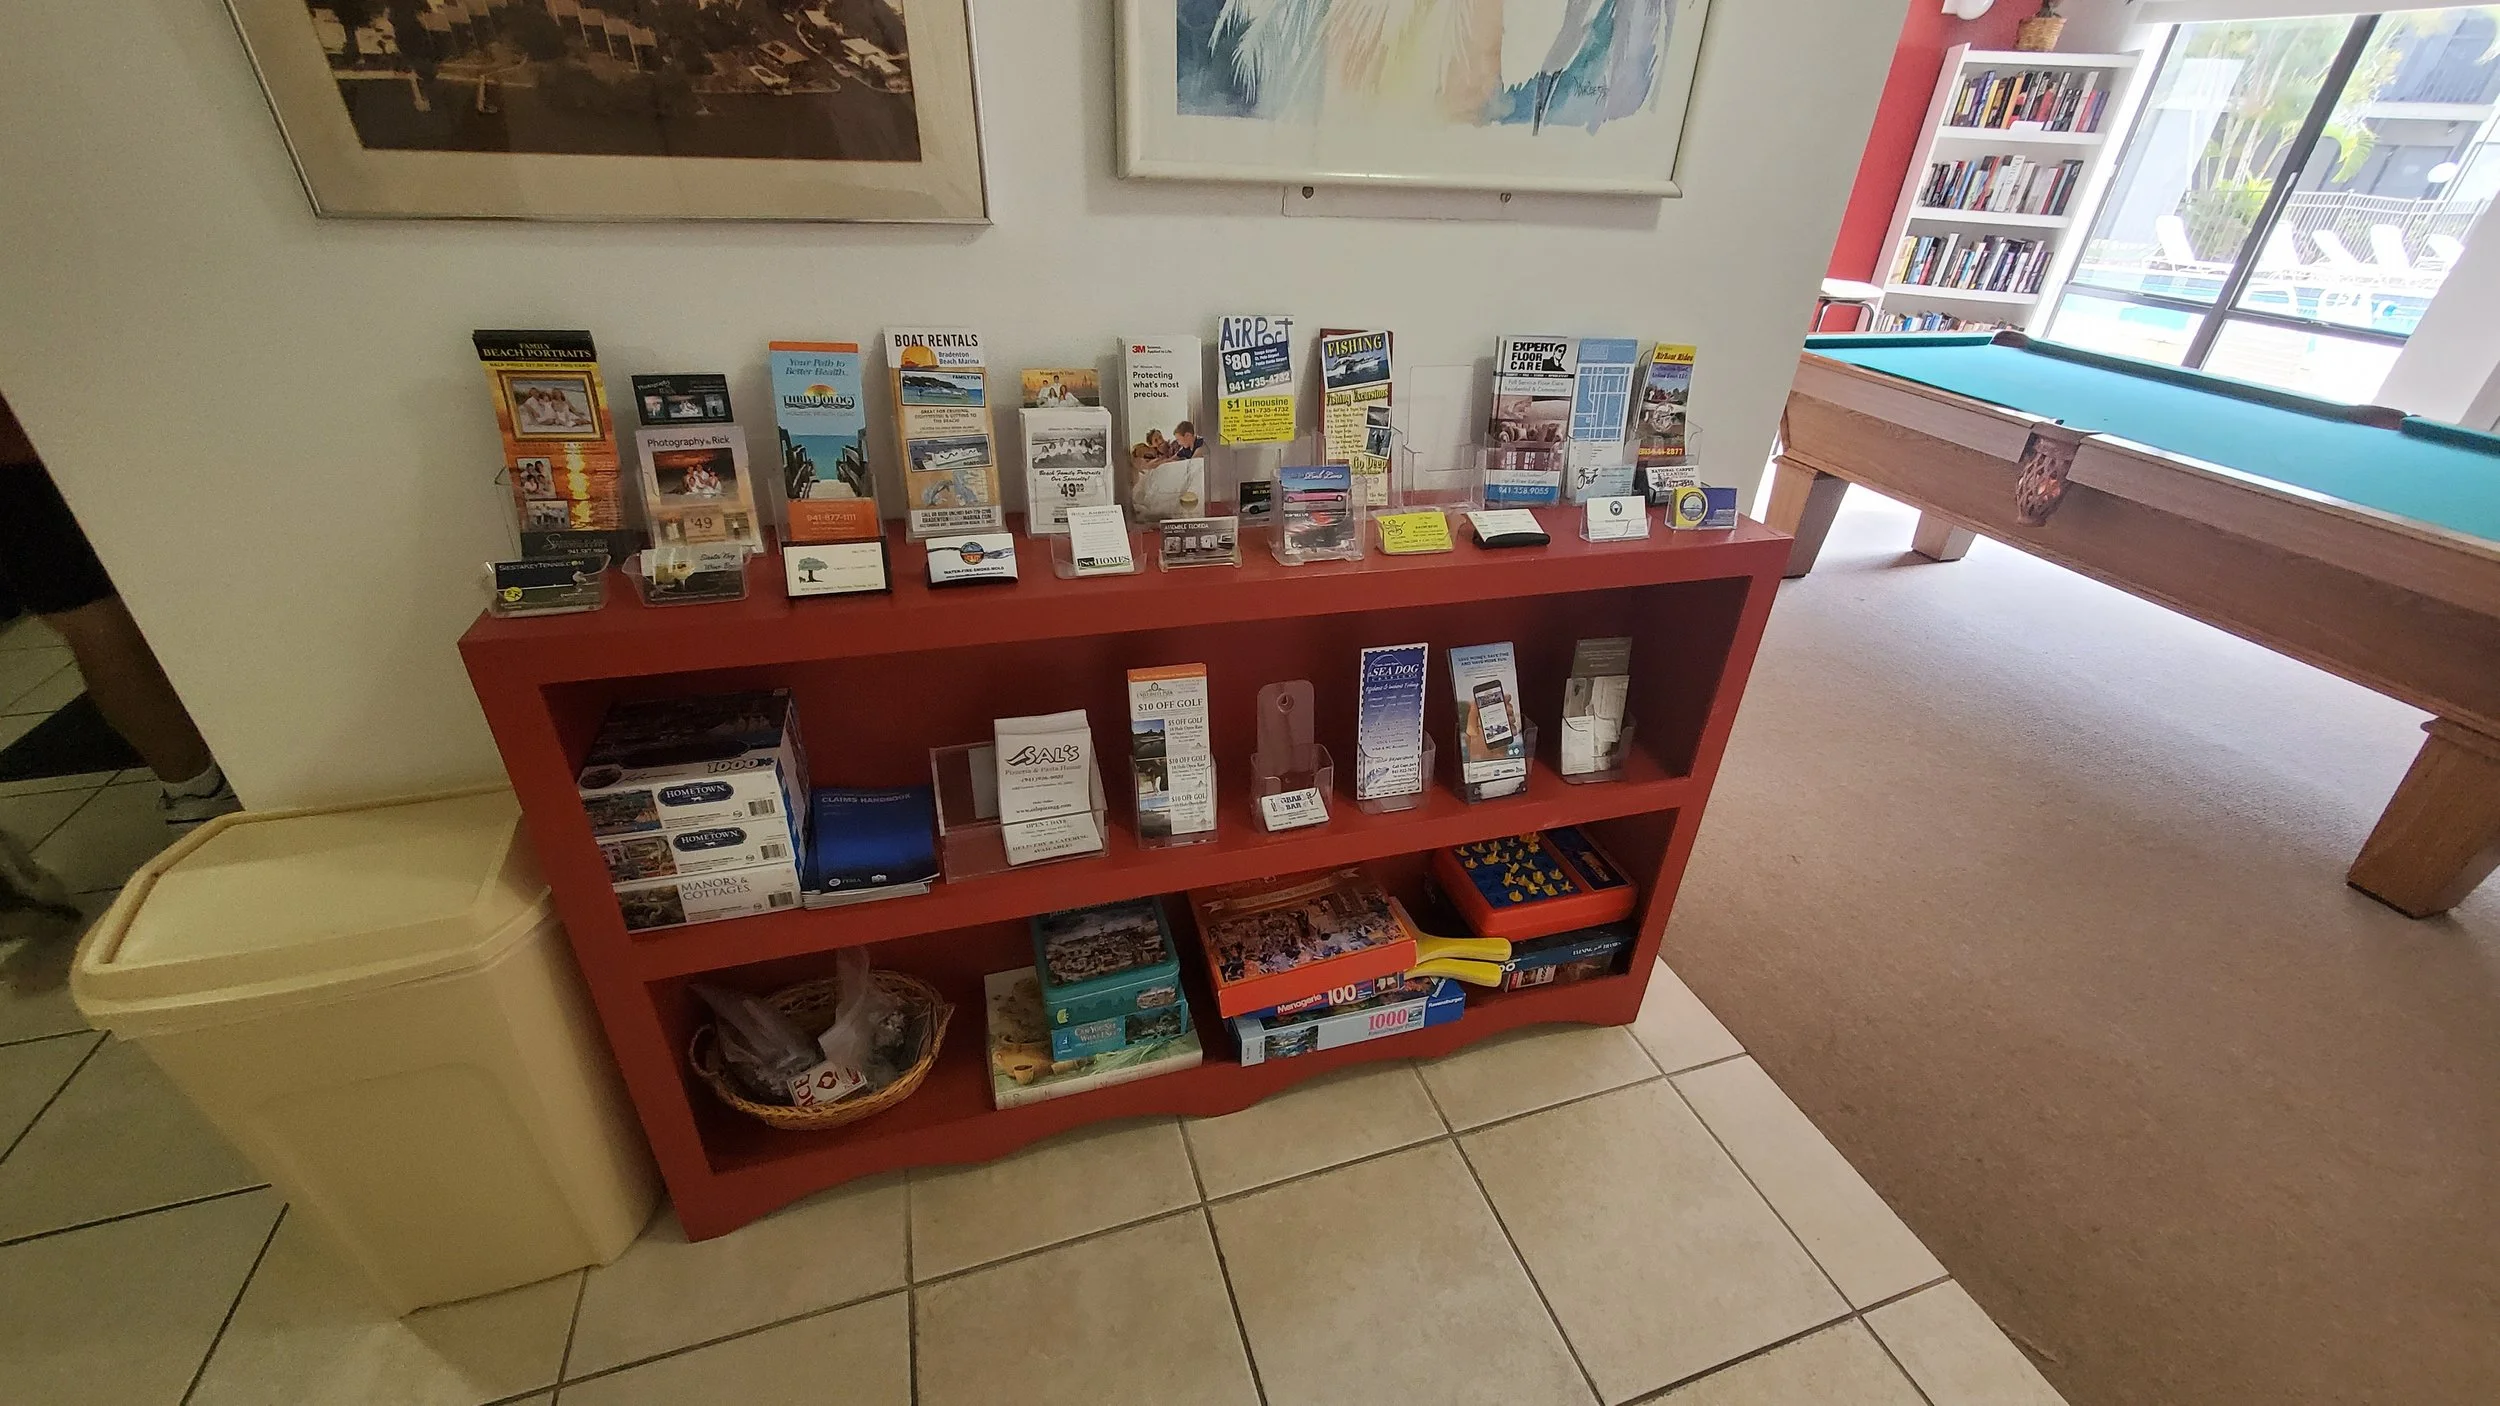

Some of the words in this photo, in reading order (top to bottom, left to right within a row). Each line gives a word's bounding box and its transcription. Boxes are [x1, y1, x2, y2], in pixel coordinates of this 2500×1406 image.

[895, 334, 924, 347] BOAT
[928, 334, 978, 347] RENTALS
[1326, 335, 1383, 357] FISHING
[1513, 342, 1556, 352] EXPERT
[483, 348, 524, 357] BEACH
[527, 349, 592, 358] PORTRAITS
[1511, 352, 1543, 361] FLOOR
[789, 358, 811, 367] Your
[813, 358, 834, 367] Path
[1225, 352, 1251, 371] $80
[1510, 361, 1542, 371] CARE
[785, 367, 812, 376] Better
[1132, 371, 1173, 380] Protecting
[1133, 380, 1159, 389] what's
[1160, 381, 1180, 389] most
[1133, 390, 1169, 399] precious.
[1227, 398, 1240, 409] $1
[1244, 397, 1289, 408] Limousine
[647, 438, 705, 449] Photography
[711, 435, 730, 445] Rick
[1373, 667, 1392, 676] SEA
[1394, 664, 1419, 675] DOG
[1138, 703, 1154, 712] $10
[1156, 701, 1175, 710] OFF
[1176, 698, 1203, 708] GOLF
[1175, 718, 1186, 726] OFF
[1006, 745, 1080, 766] SAL'S
[707, 760, 759, 774] 1000
[666, 785, 727, 799] HOMETOWN
[681, 830, 739, 844] HOMETOWN
[681, 877, 737, 893] MANORS
[682, 884, 751, 900] COTTAGES
[1327, 984, 1357, 1006] 100
[1277, 993, 1323, 1014] Menagerie
[1368, 1008, 1408, 1030] 1000
